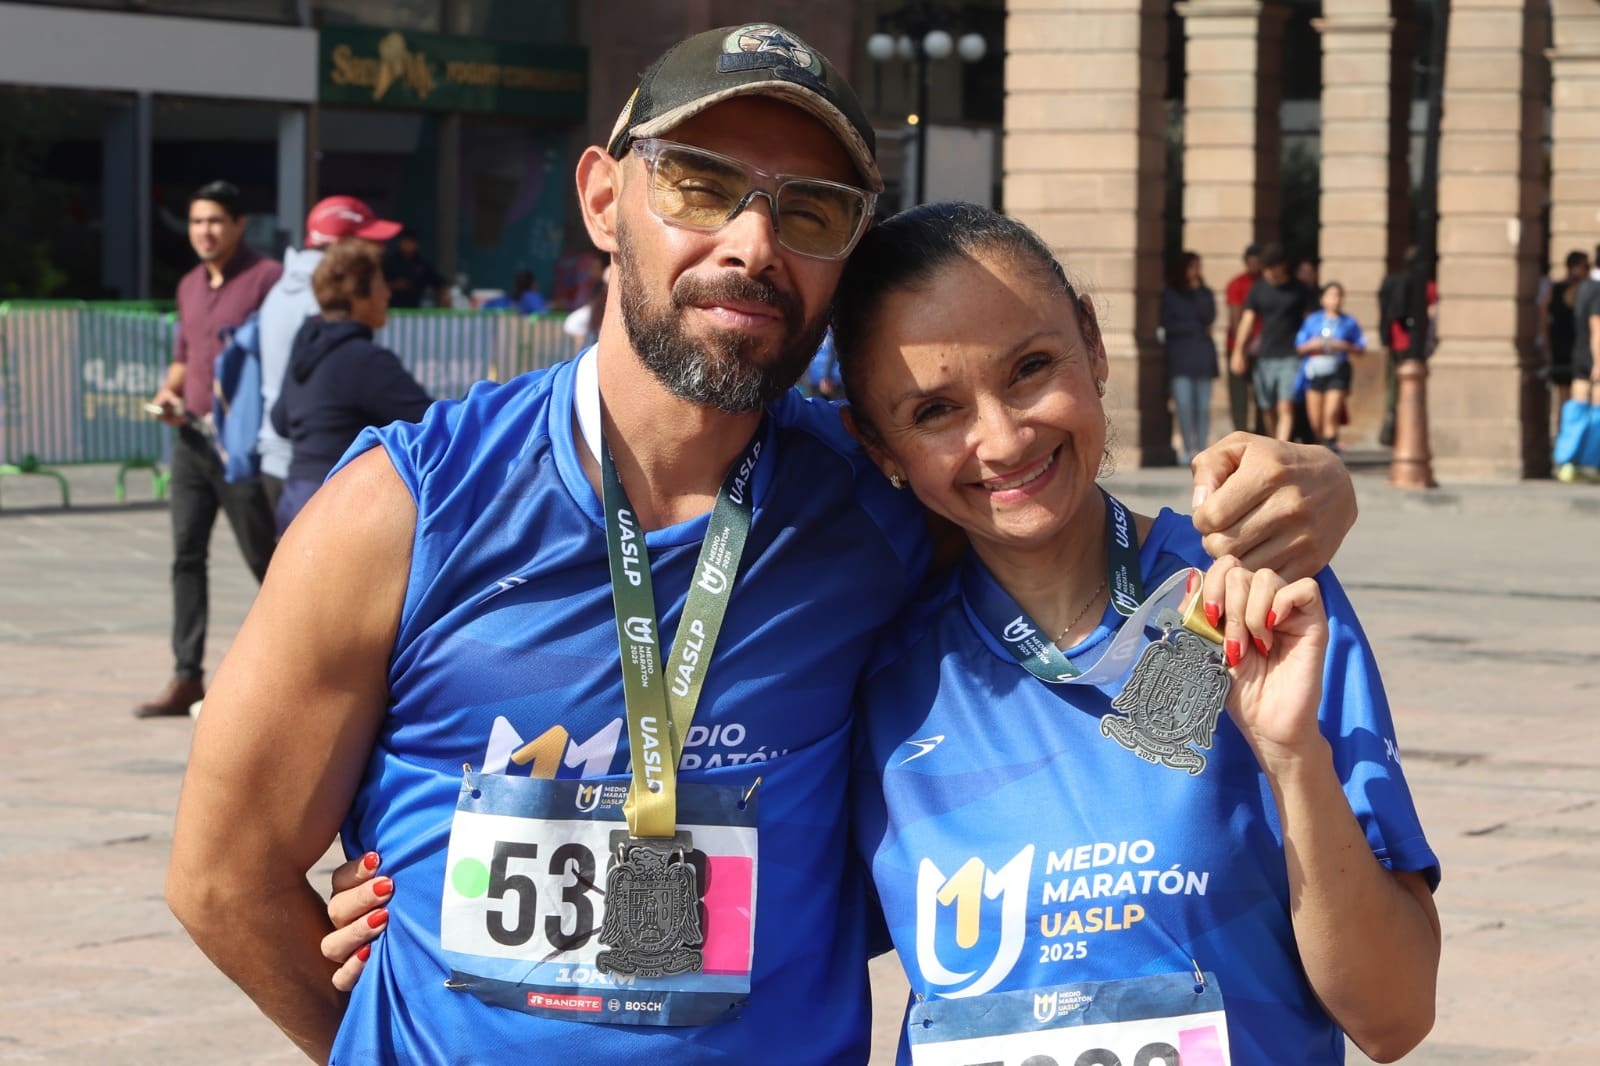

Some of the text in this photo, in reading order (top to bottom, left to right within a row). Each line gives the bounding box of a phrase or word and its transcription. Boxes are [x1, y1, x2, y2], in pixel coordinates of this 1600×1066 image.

[729, 441, 761, 504] UASLP
[617, 508, 642, 587] UASLP
[709, 535, 721, 562] MEDIO
[630, 644, 639, 665] 2025
[645, 646, 654, 674] MEDIO
[671, 618, 705, 697] UASLP
[640, 716, 664, 795] UASLP
[1138, 748, 1156, 762] 2025
[1045, 839, 1155, 875] MEDIO
[486, 841, 712, 951] 53
[1041, 864, 1209, 906] MARATÓN
[1040, 904, 1145, 938] UASLP
[1039, 941, 1088, 964] 2025
[545, 998, 662, 1012] BANORTE BOSCH
